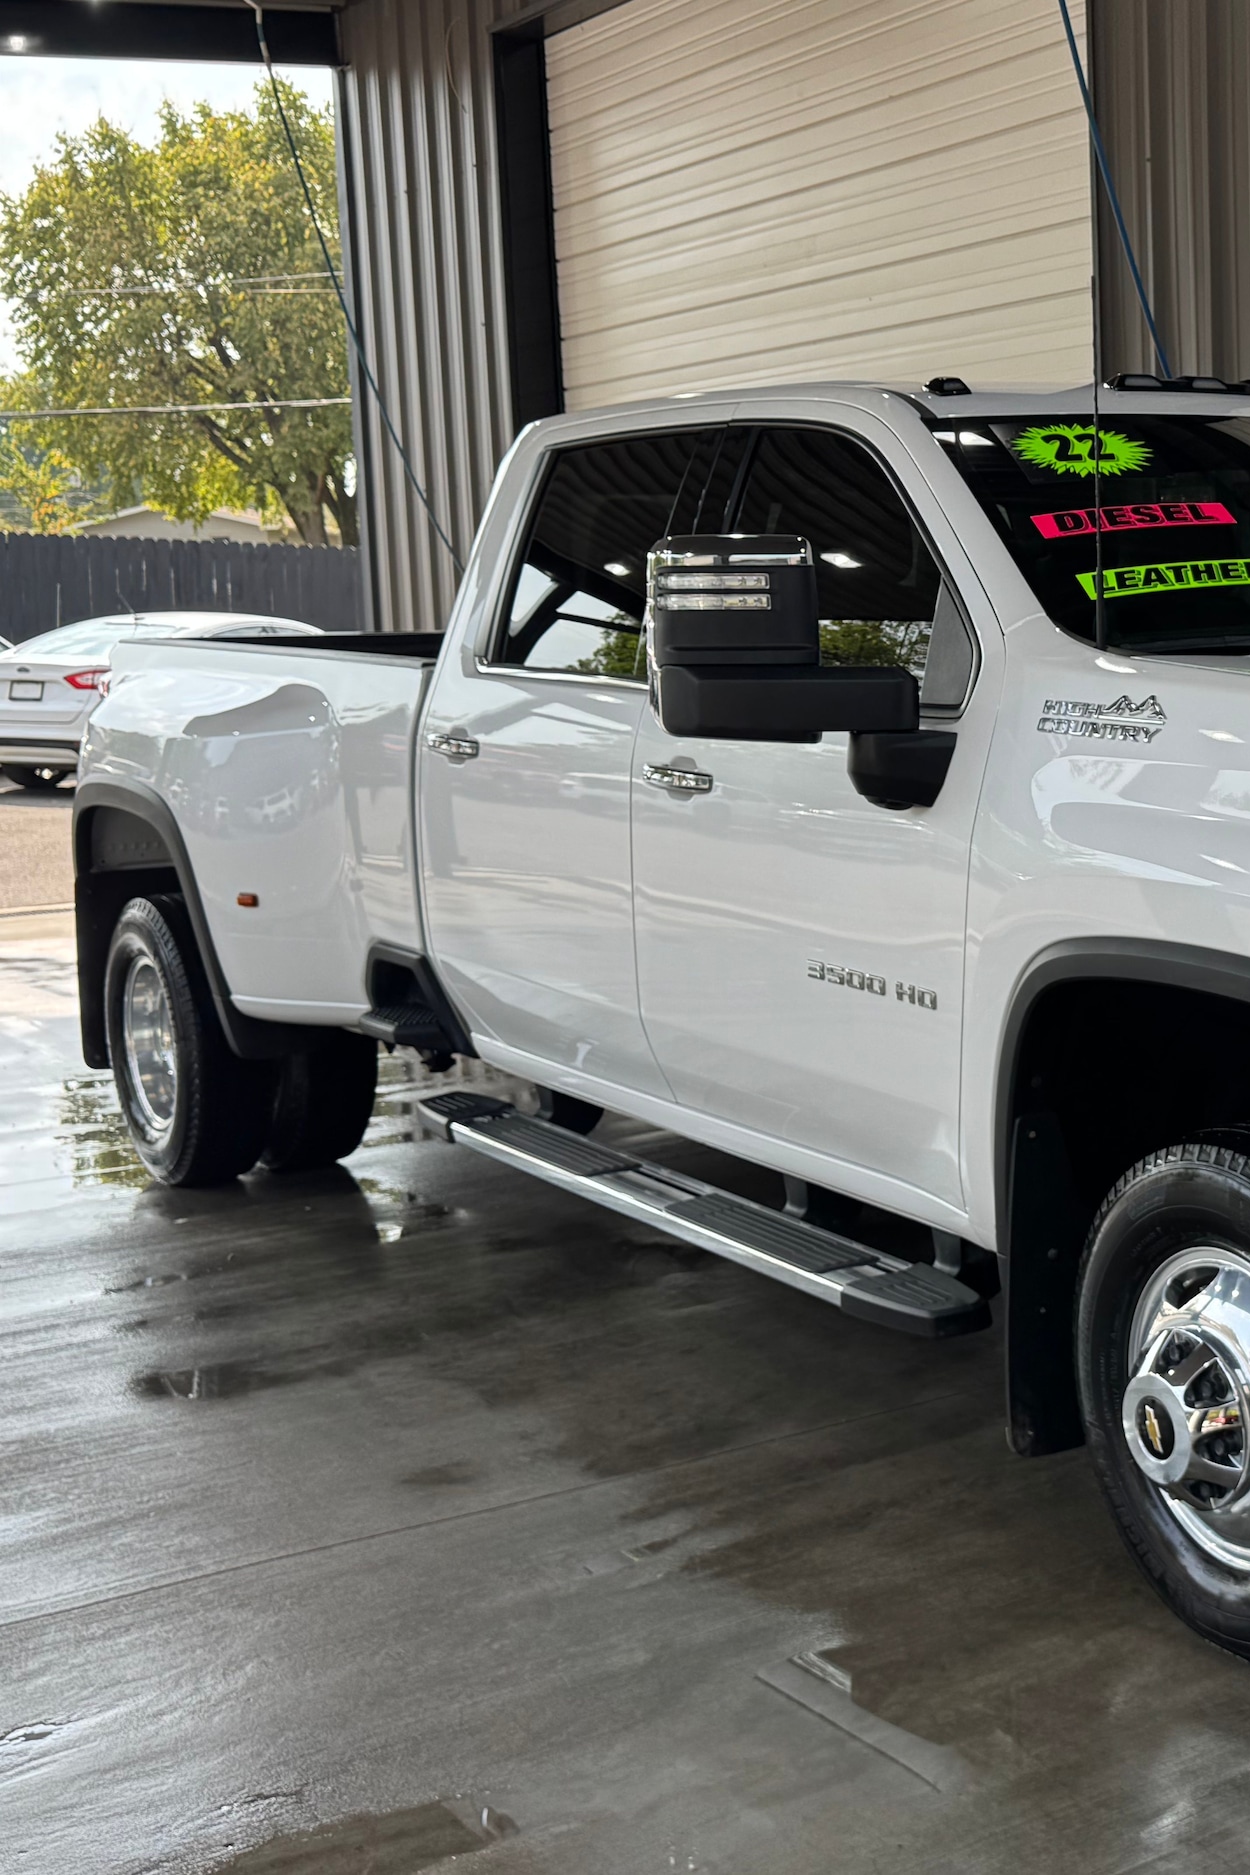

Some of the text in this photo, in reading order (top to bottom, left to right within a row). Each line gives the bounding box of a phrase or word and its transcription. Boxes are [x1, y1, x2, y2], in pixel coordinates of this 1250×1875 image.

[1041, 433, 1119, 463] 22
[1051, 503, 1222, 535] DIESEL
[1042, 699, 1106, 718] HIGH
[1037, 718, 1163, 743] COUNTRY
[807, 959, 937, 1010] 3500 HD
